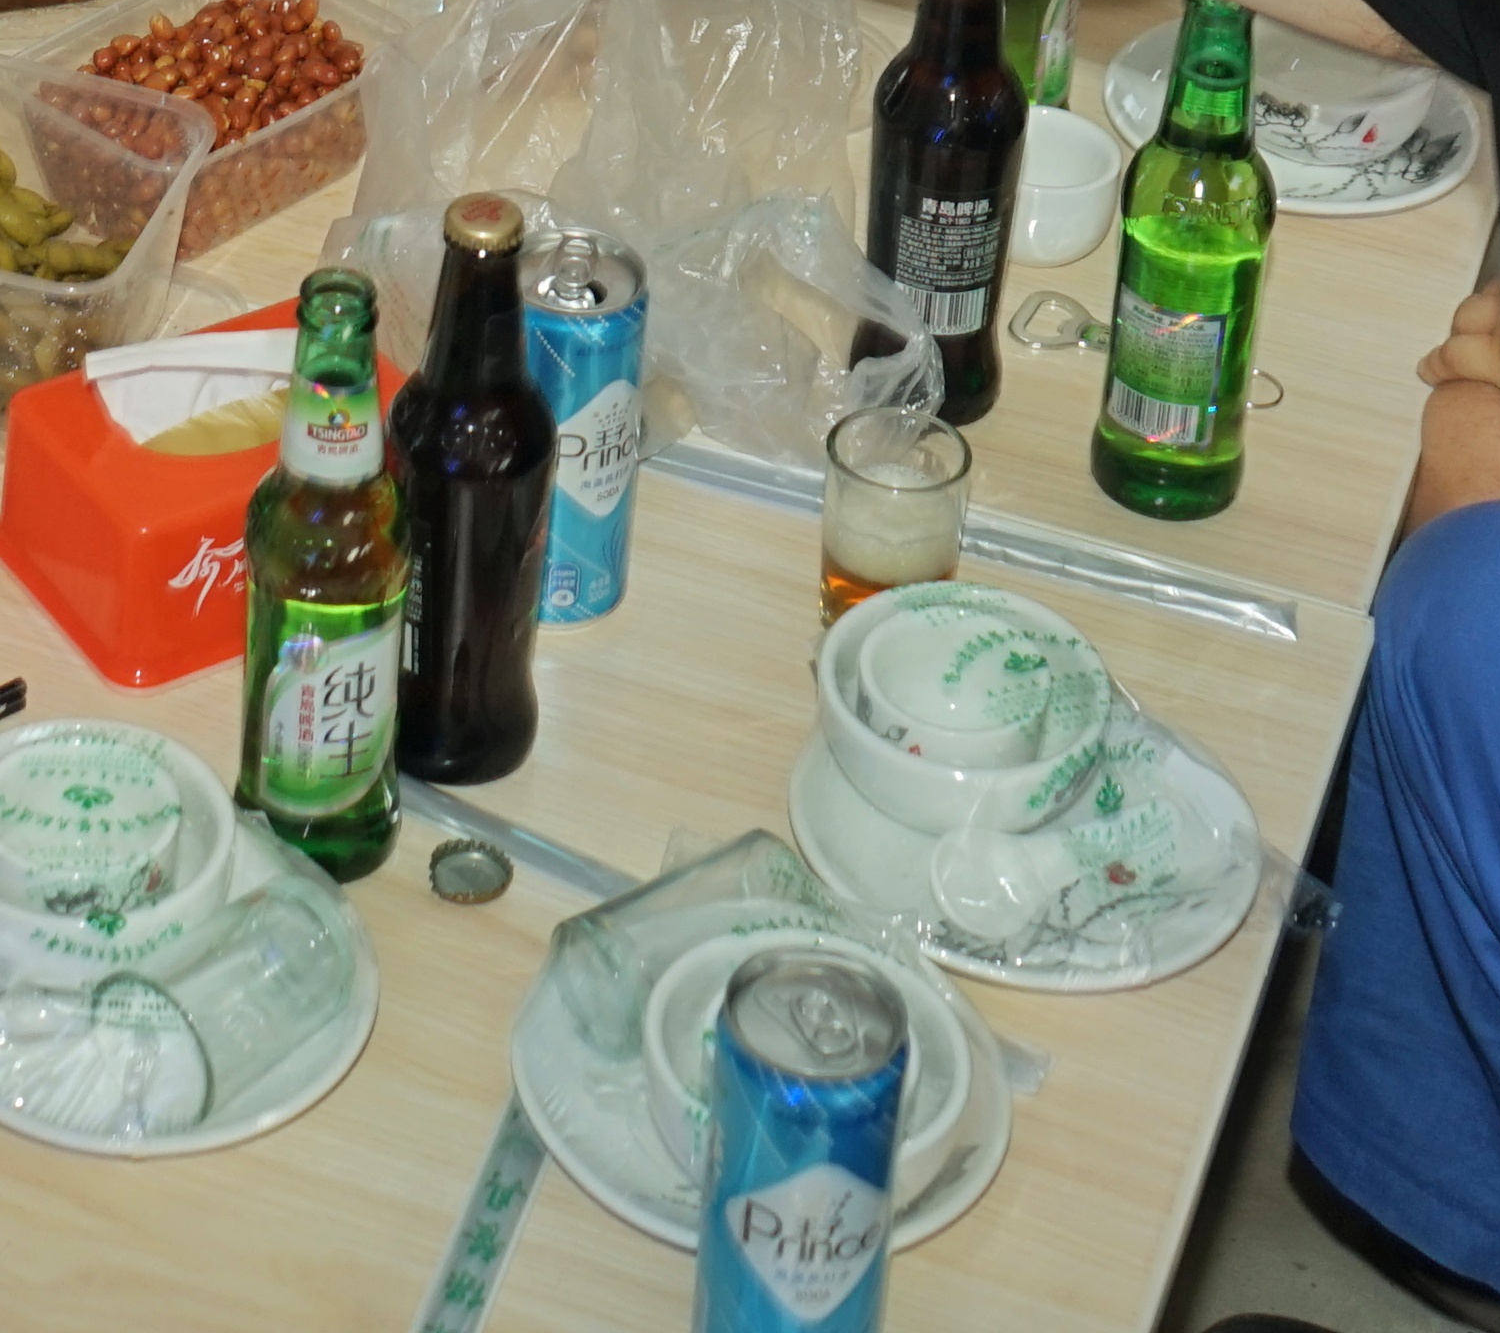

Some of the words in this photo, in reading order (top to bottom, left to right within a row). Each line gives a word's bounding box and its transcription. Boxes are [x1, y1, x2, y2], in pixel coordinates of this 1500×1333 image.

[557, 430, 636, 472] Princ
[596, 486, 621, 503] SODA
[320, 661, 377, 780] 纯生
